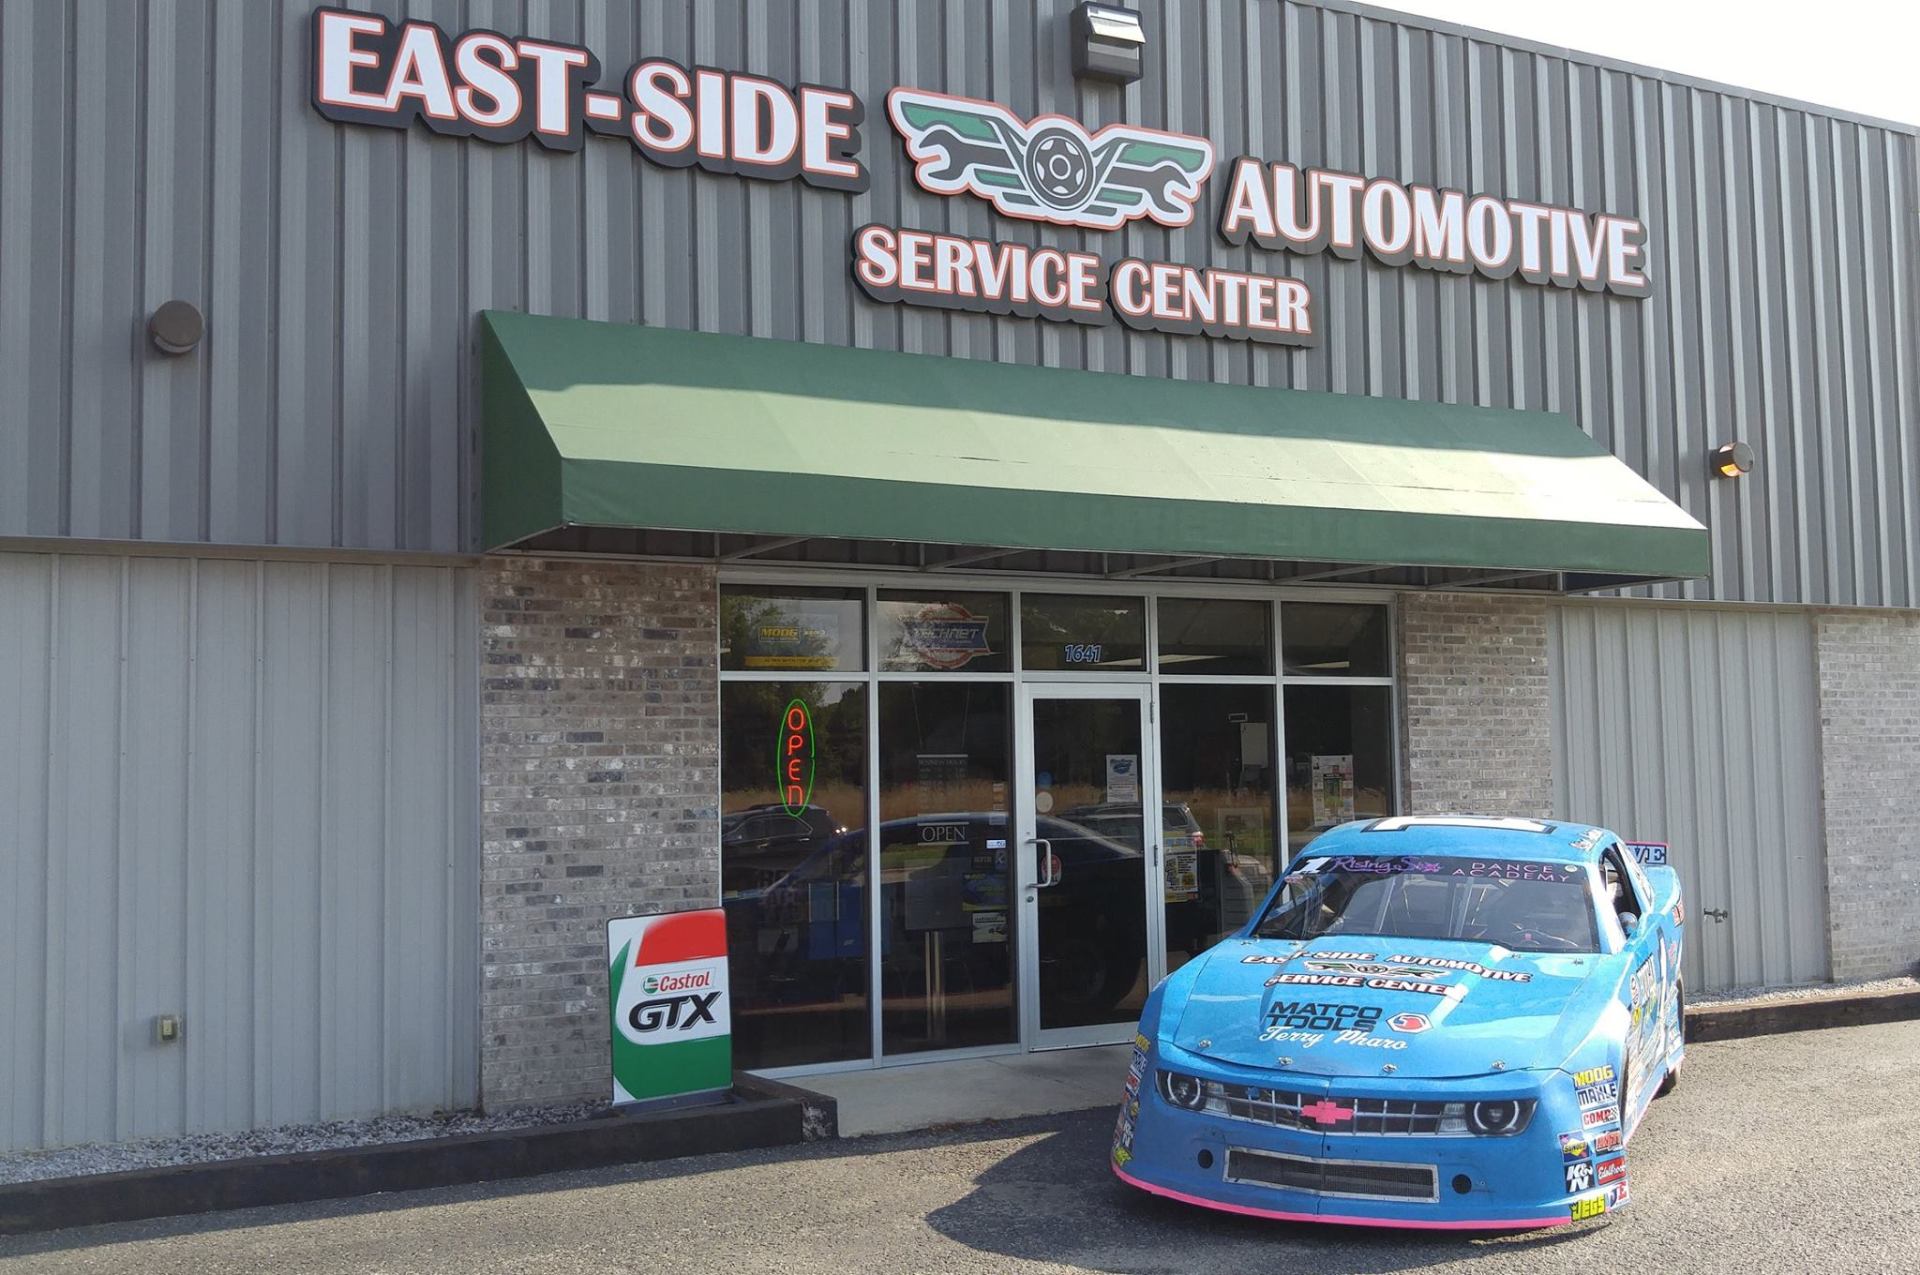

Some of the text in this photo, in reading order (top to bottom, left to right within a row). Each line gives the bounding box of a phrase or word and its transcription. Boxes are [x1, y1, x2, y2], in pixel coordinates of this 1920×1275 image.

[318, 11, 1647, 287] EAST-SIDE AUTOMOTIVE
[856, 225, 1311, 334] SERVICE CENTER
[761, 628, 799, 638] MOOG
[1065, 644, 1102, 663] 1641
[787, 707, 805, 806] OPEN
[922, 825, 966, 842] OPEN
[1452, 868, 1570, 883] ACADEMY
[1472, 862, 1552, 873] DANCE
[1241, 949, 1533, 982] EAST-SIDE AUTOMOTIVE
[659, 971, 710, 992] Castrol
[1264, 973, 1367, 988] SERVICE
[629, 991, 723, 1033] GTX
[1269, 1001, 1383, 1020] MATCO
[1265, 1014, 1377, 1033] TOOLS
[1259, 1026, 1409, 1050] Terry Pharo
[1574, 1065, 1615, 1087] MOOG
[1566, 1163, 1594, 1193] K&N
[1571, 1196, 1606, 1221] JEGS
